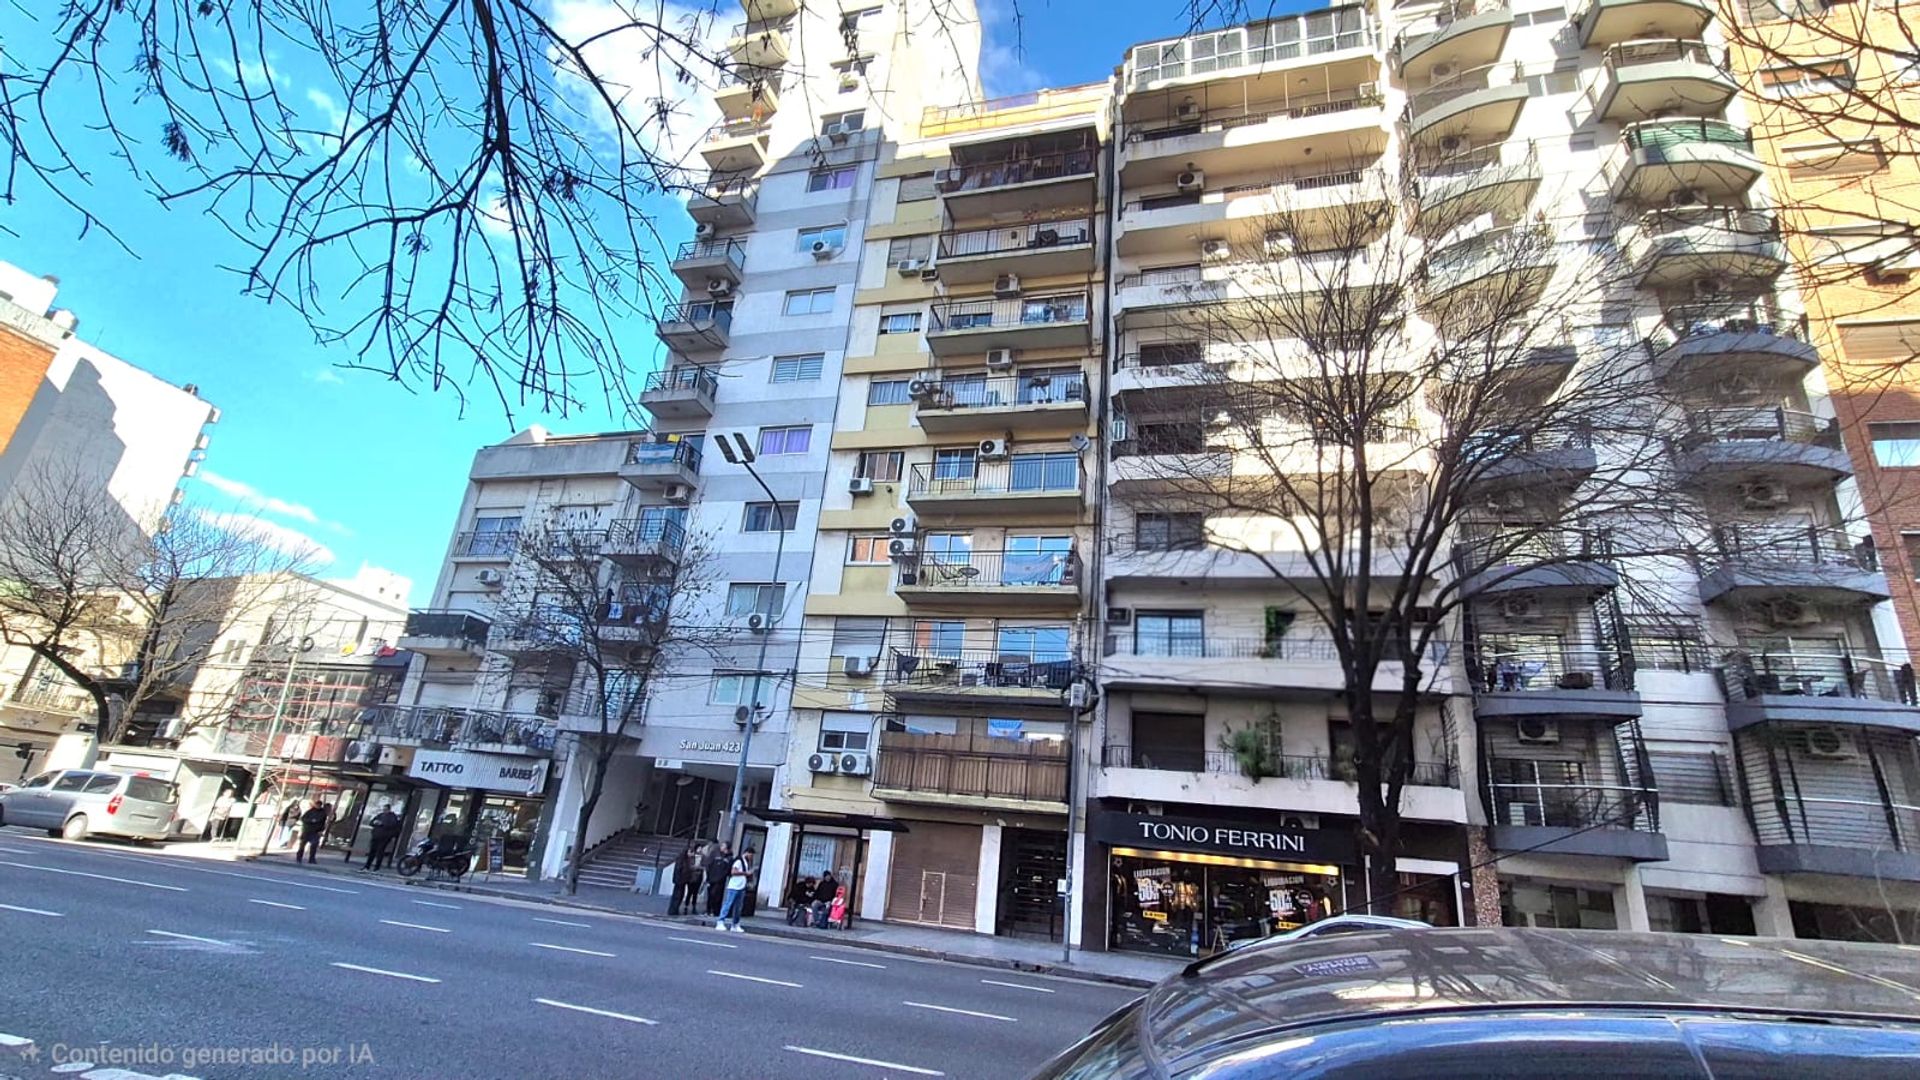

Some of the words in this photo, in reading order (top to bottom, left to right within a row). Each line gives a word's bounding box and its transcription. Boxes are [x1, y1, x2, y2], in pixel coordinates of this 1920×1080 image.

[680, 739, 698, 750] San
[698, 741, 721, 752] Juan
[722, 741, 744, 753] 423
[420, 761, 464, 774] TATTOO
[1139, 821, 1208, 843] TONIO
[1215, 828, 1304, 852] FERRINI
